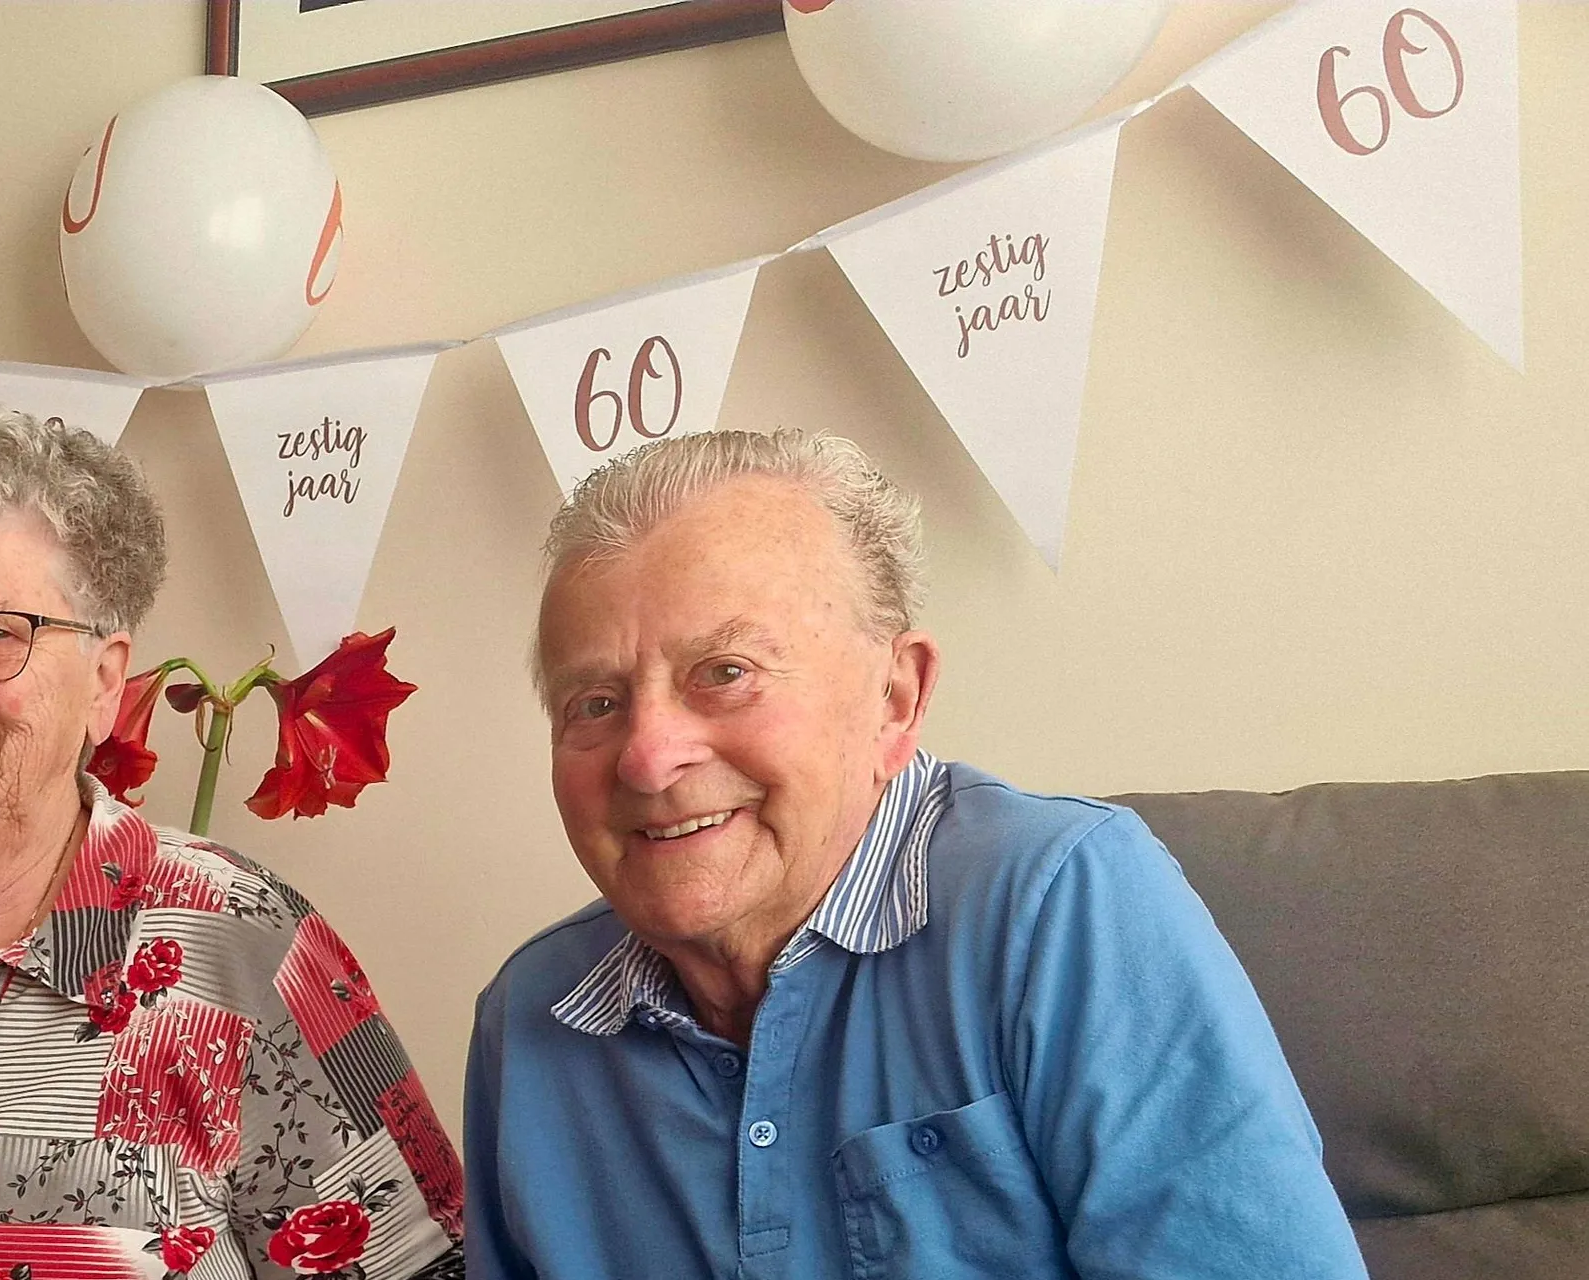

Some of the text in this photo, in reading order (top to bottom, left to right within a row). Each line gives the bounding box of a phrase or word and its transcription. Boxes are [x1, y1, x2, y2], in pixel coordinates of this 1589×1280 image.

[1315, 6, 1465, 158] 60
[931, 233, 1051, 298] zestig
[954, 283, 1052, 359] jaar
[574, 335, 683, 453] 60
[276, 416, 368, 469] zestig
[283, 468, 362, 518] jaar
